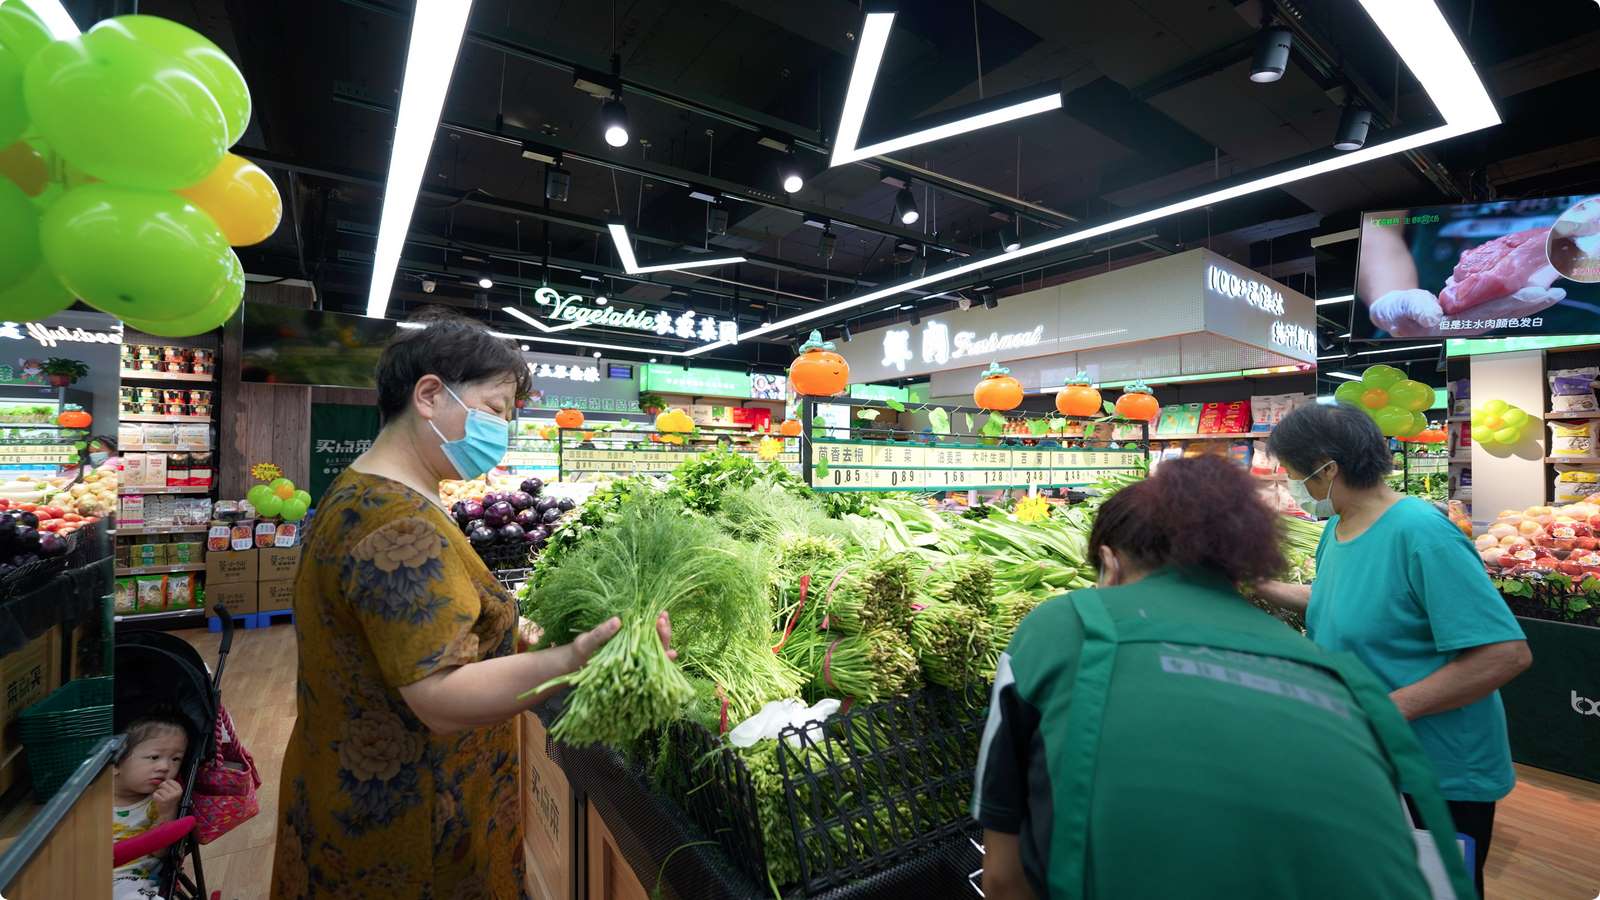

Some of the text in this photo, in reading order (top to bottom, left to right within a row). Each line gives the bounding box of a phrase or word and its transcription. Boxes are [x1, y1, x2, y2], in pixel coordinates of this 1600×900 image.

[534, 287, 654, 331] Vegetable
[1439, 316, 1544, 331] 但是注水肉颜色发白
[315, 439, 372, 453] 买点菜
[972, 452, 1006, 464] 大叶生菜
[834, 469, 860, 486] 0.85
